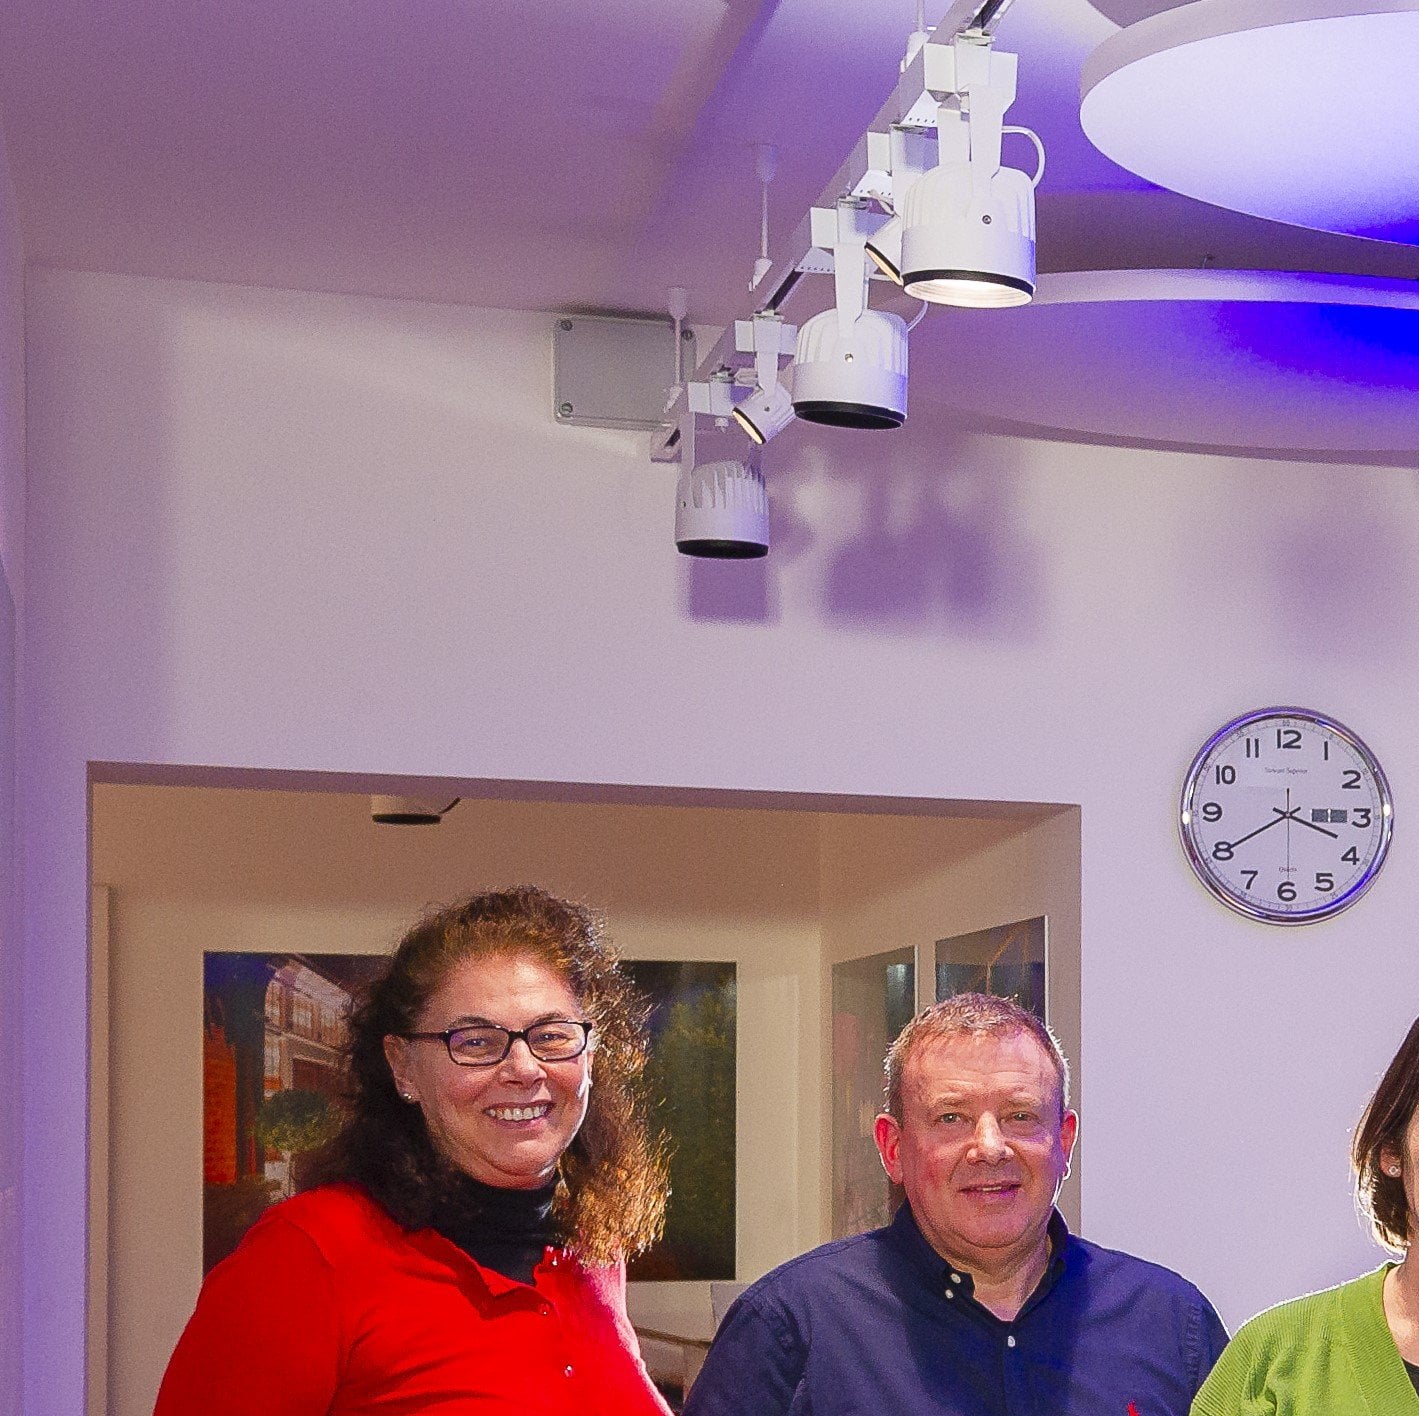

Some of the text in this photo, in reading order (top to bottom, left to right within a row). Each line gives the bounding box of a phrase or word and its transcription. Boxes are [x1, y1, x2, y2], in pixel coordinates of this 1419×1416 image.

[1246, 738, 1259, 758] 11
[1276, 729, 1302, 749] 12
[1324, 741, 1328, 760] 1
[1216, 765, 1236, 785] 10
[1342, 770, 1361, 789] 2
[1202, 802, 1222, 822] 9
[1351, 808, 1371, 828] 3
[1212, 841, 1234, 861] 8
[1341, 846, 1360, 865] 4
[1240, 870, 1258, 889] 7
[1314, 873, 1334, 892] 5
[1277, 882, 1297, 901] 6
